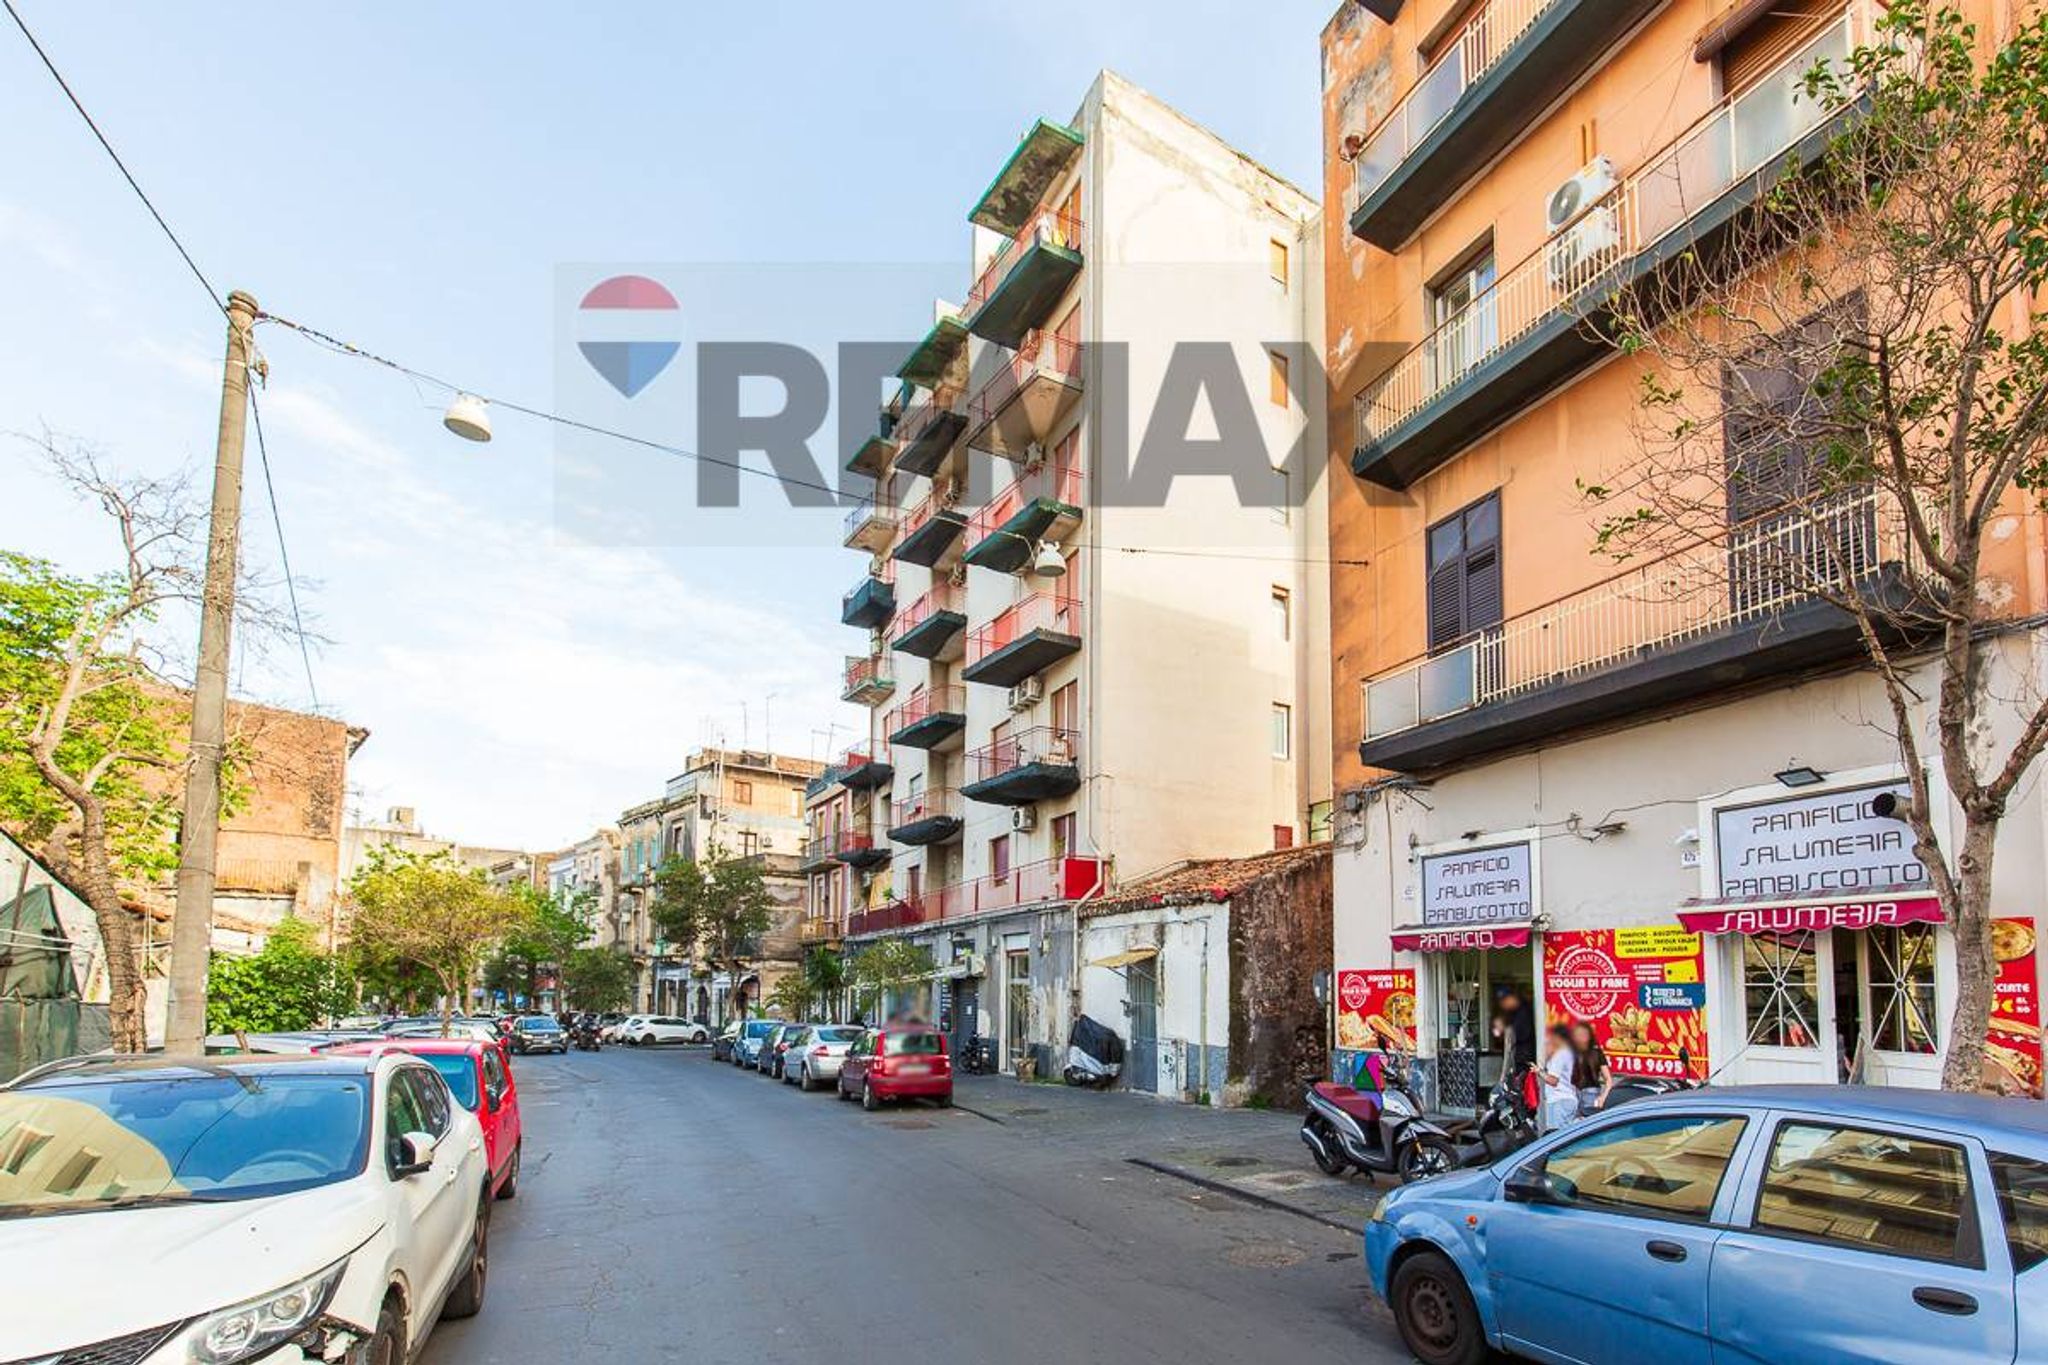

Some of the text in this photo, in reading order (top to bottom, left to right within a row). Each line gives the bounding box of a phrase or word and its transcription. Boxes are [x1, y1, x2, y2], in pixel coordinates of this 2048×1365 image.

[1740, 831, 1903, 866] SALUMERIA
[1441, 856, 1510, 878] PANIFICIO
[1435, 879, 1520, 901] SALUMERIA
[1725, 863, 1923, 897] PANBISCOTTO
[1427, 901, 1530, 921] PANBISCOTTO
[1717, 902, 1898, 932] SALUMERIA
[1420, 931, 1494, 949] PANIFICIO
[1549, 978, 1586, 989] VOGLIA
[1587, 978, 1600, 989] DI
[1601, 978, 1630, 989] PANE
[1993, 983, 2031, 993] CIATE
[1615, 1057, 1642, 1071] 718
[1645, 1058, 1684, 1075] 9695
